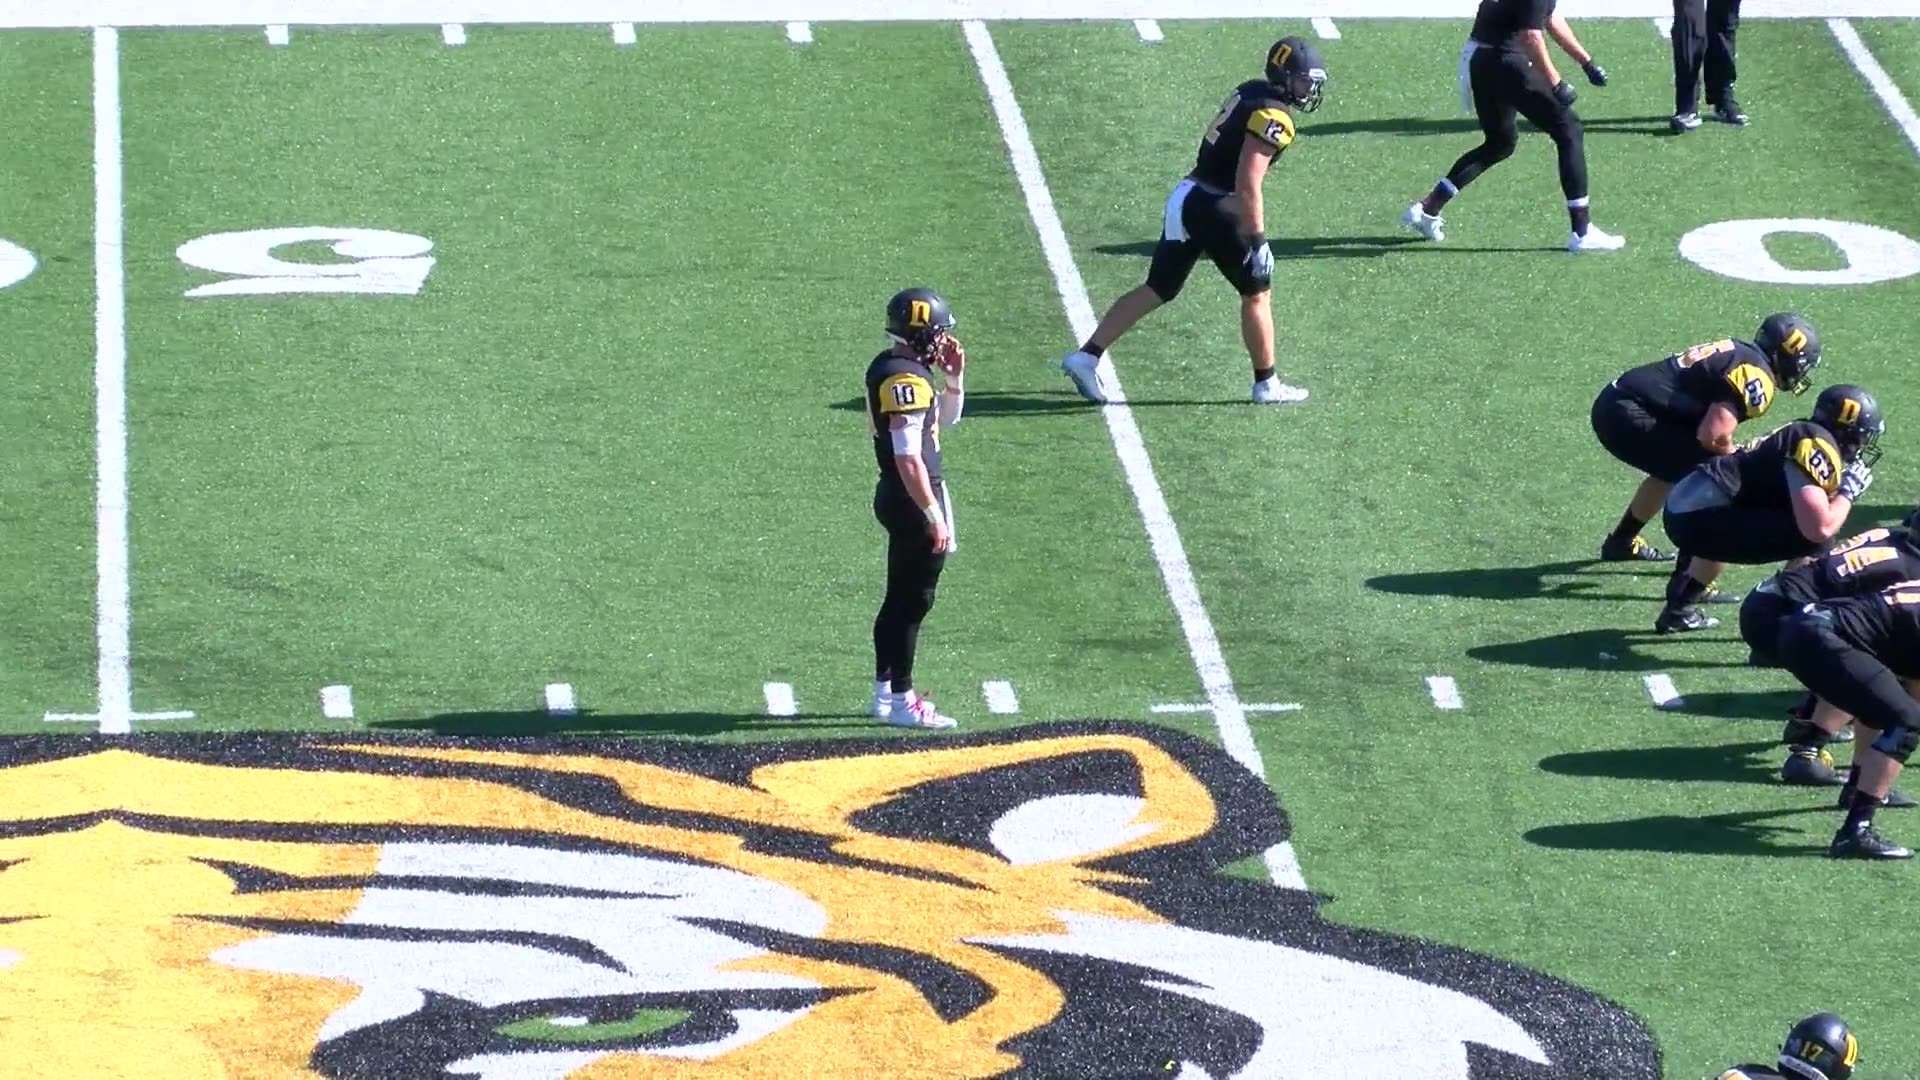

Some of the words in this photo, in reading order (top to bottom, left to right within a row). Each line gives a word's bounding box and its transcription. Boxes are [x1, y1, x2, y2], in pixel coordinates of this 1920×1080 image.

[1265, 118, 1286, 142] 12
[0, 226, 437, 297] 5
[891, 383, 915, 406] 10
[1801, 1041, 1824, 1062] 17
